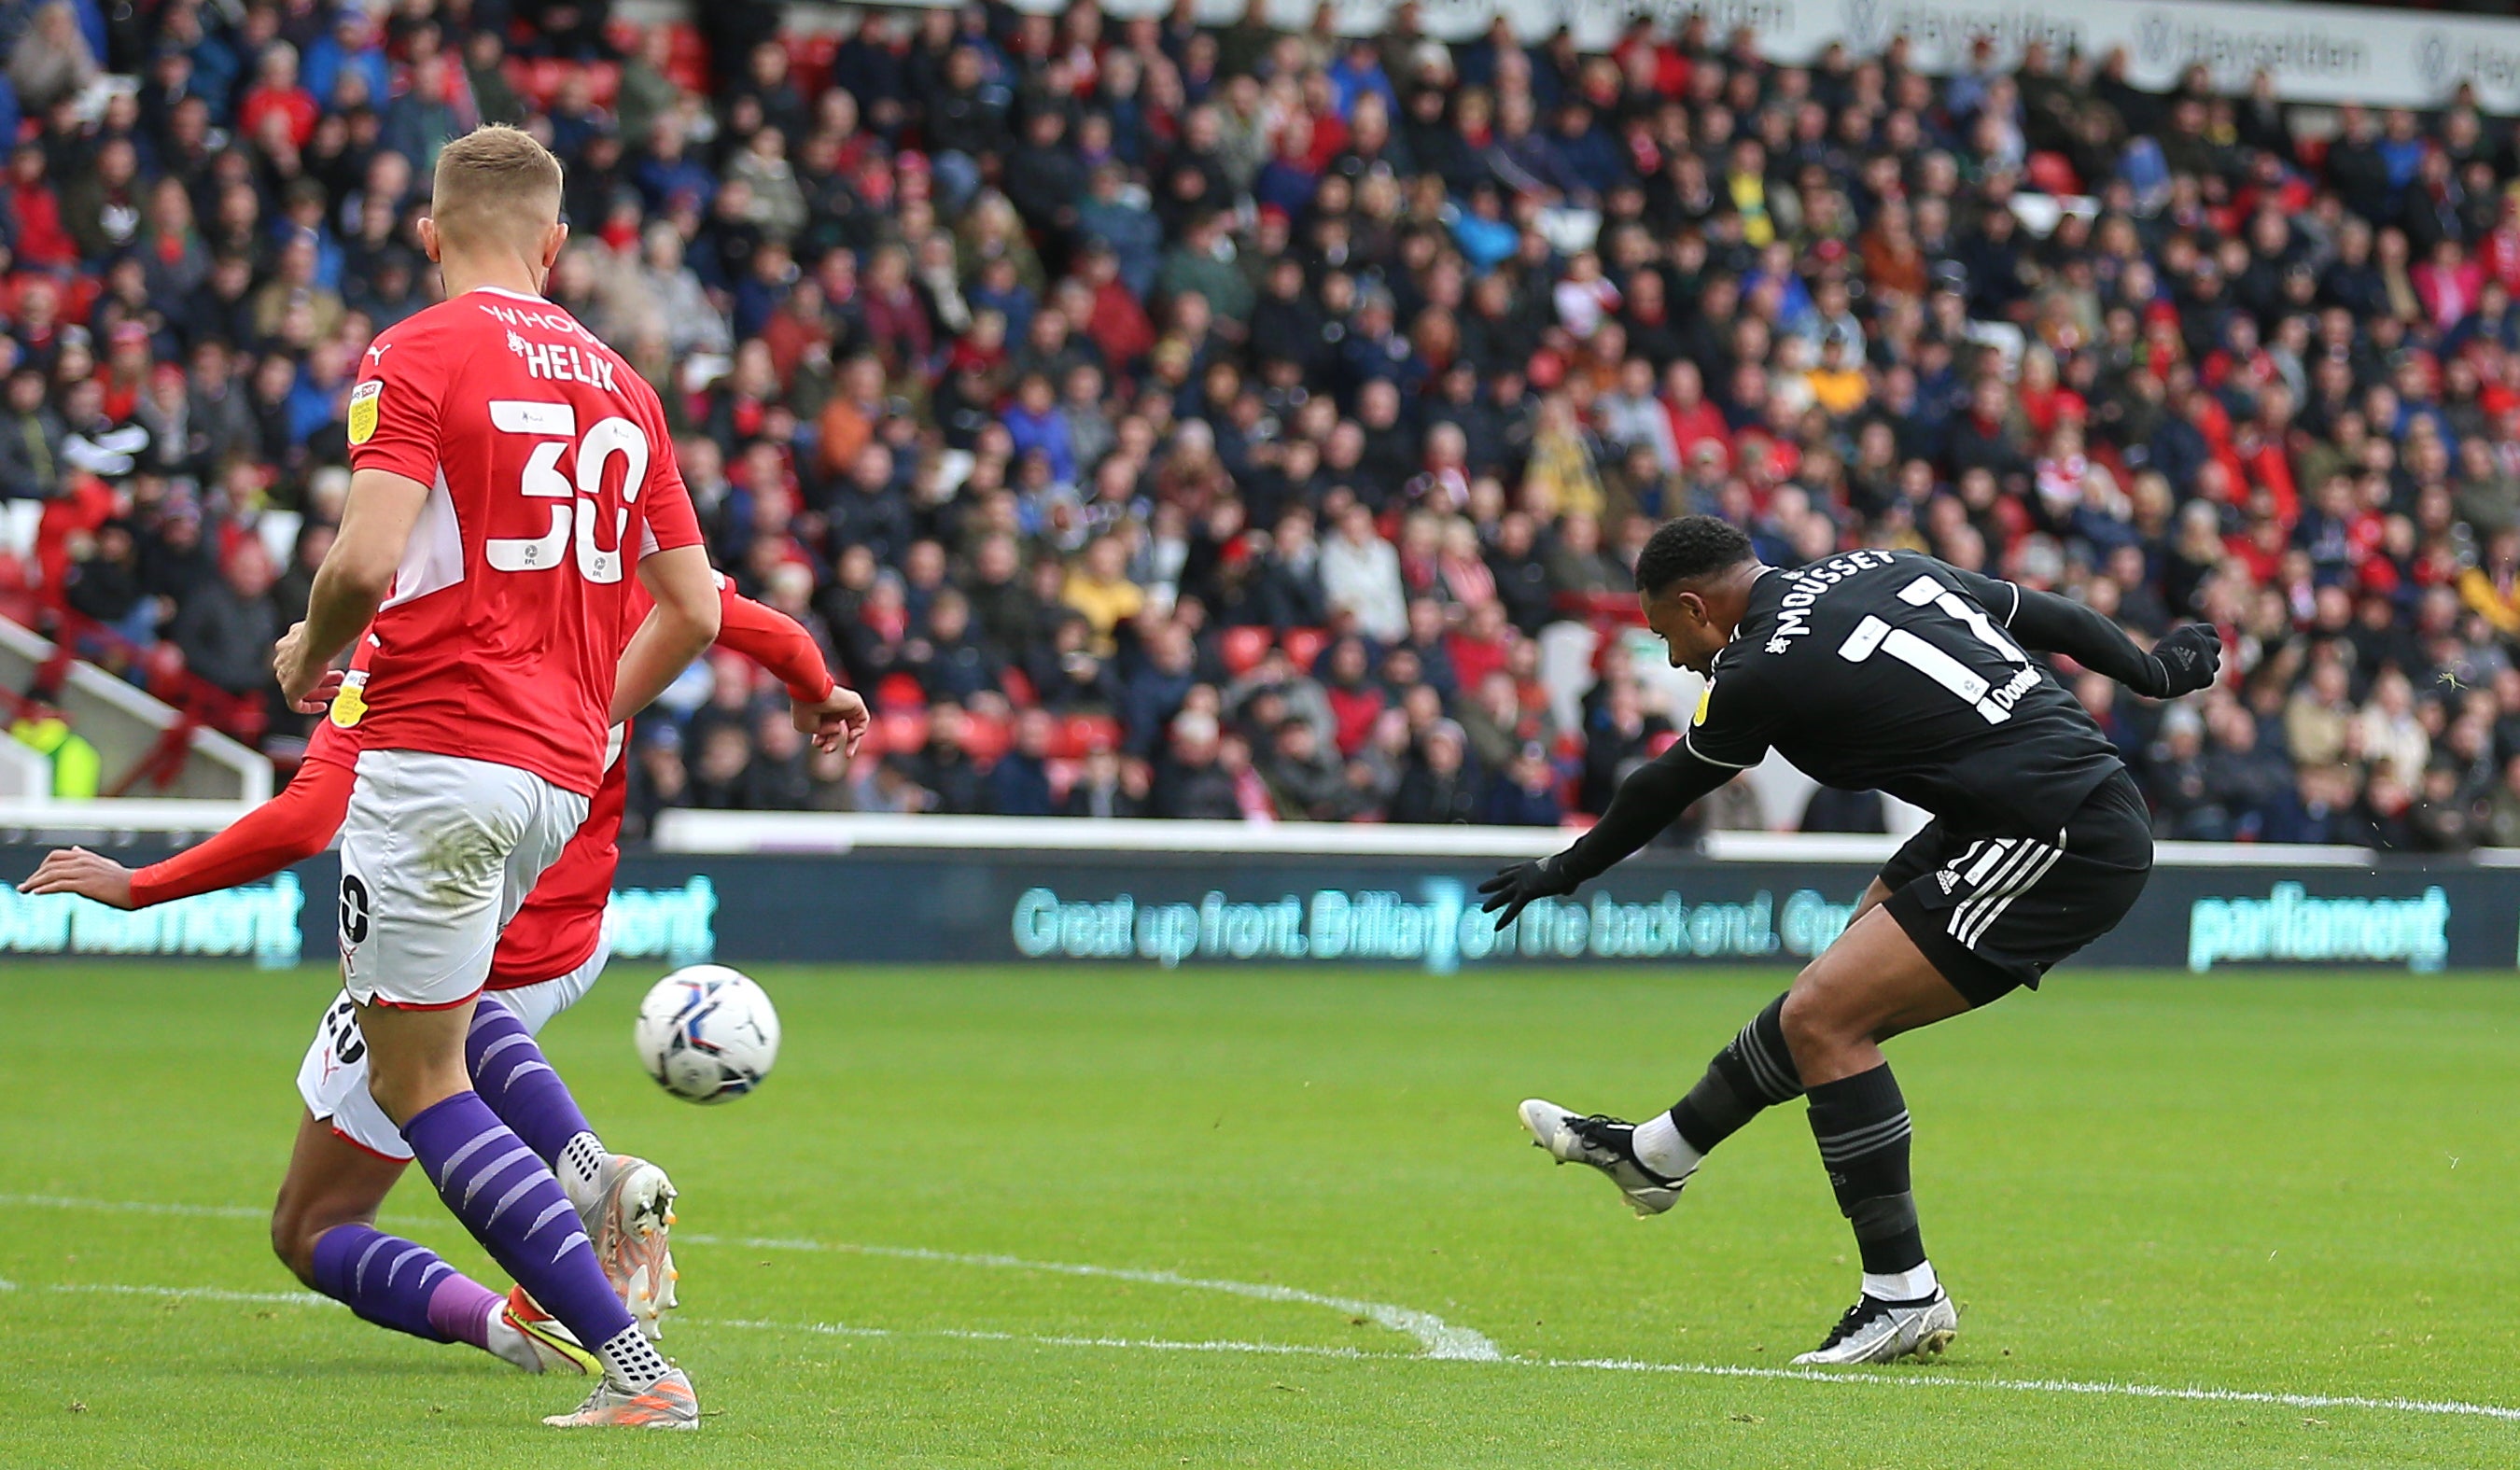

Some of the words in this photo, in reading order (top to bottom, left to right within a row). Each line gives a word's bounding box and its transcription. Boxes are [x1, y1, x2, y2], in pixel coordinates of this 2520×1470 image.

[486, 400, 649, 584] 30
[1776, 550, 1896, 636] MOUSSET
[1013, 887, 1135, 959] Great
[1136, 902, 1201, 969] up
[1589, 889, 1690, 959] back
[2187, 880, 2450, 972] parliament
